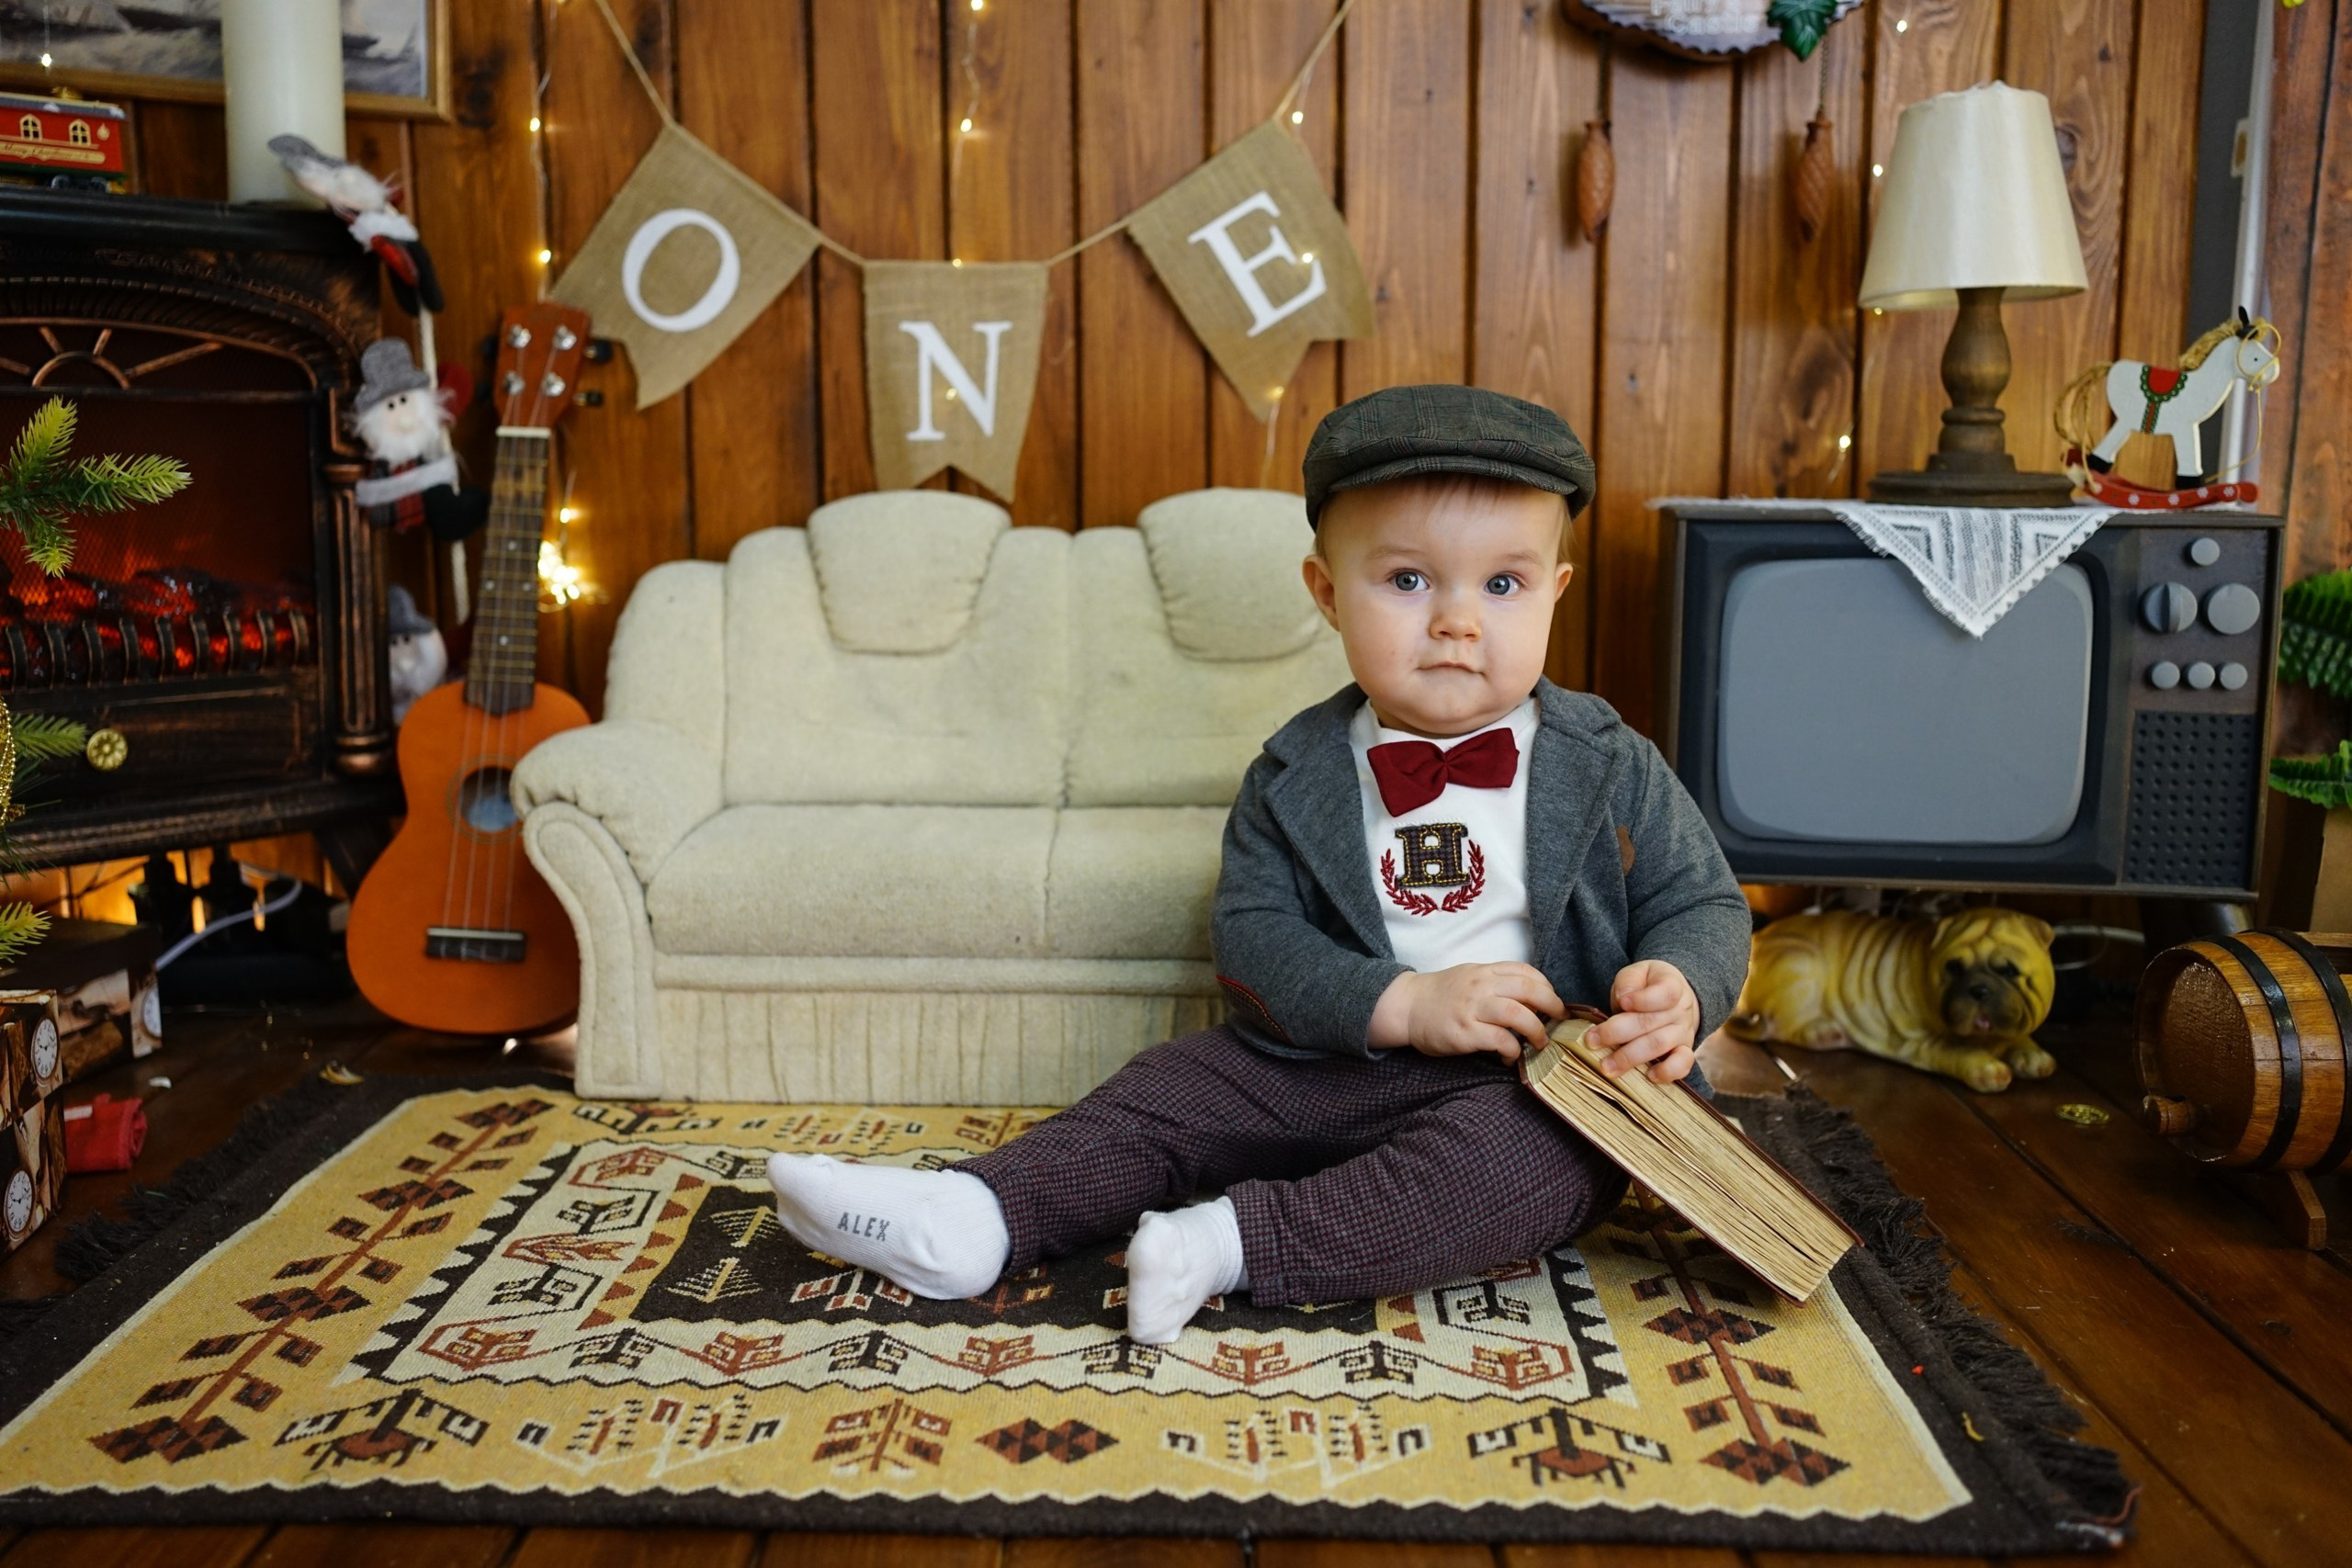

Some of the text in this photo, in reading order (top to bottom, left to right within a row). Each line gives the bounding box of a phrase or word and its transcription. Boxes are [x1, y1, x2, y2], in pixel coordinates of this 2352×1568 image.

[622, 190, 1328, 441] ONE
[1395, 823, 1470, 888] H
[837, 1212, 890, 1241] ALEX
